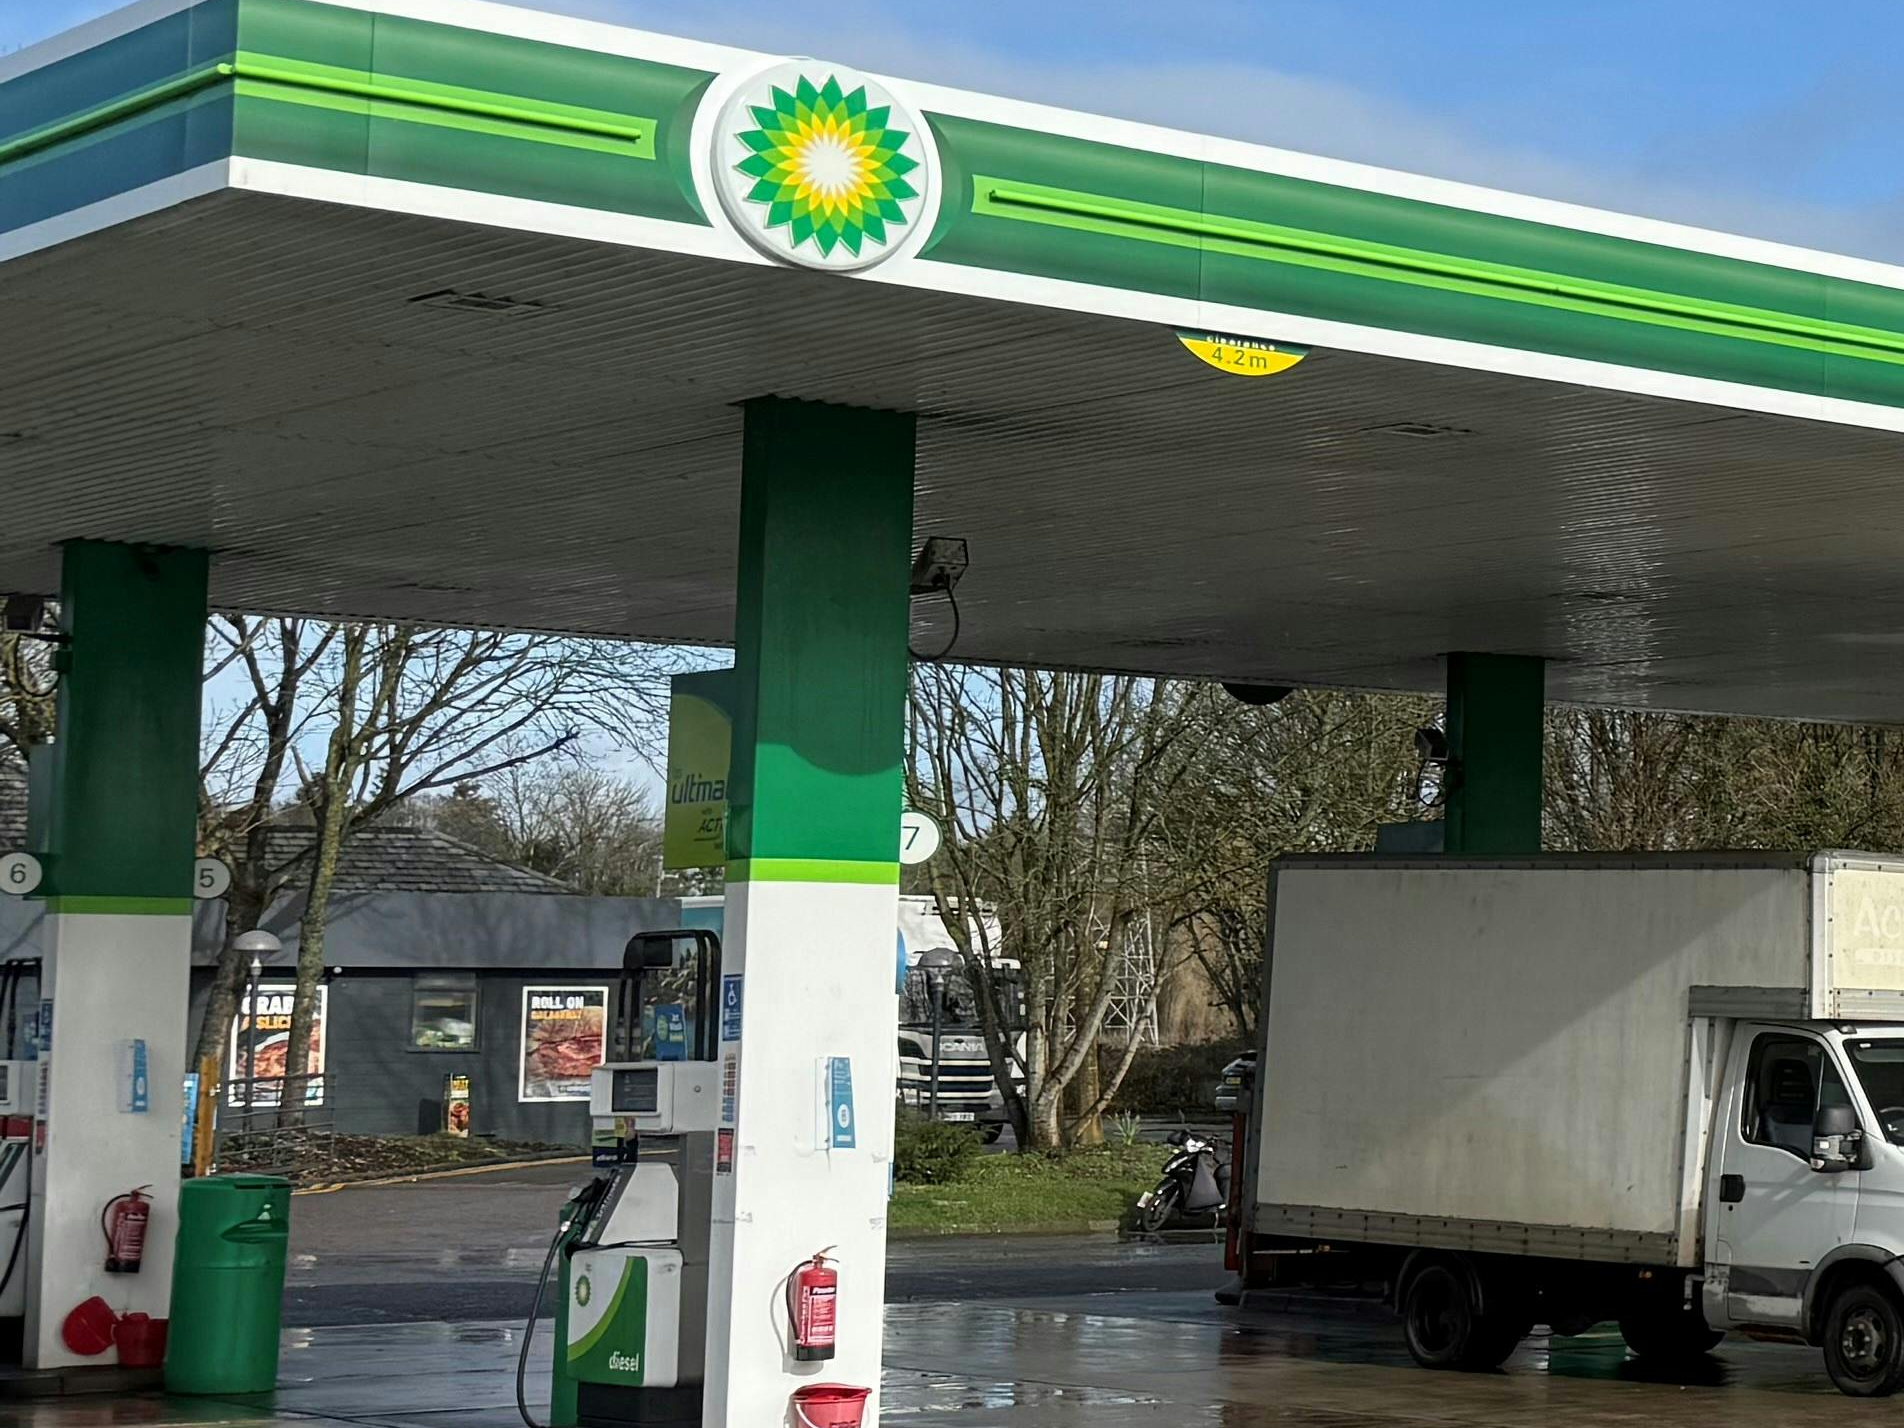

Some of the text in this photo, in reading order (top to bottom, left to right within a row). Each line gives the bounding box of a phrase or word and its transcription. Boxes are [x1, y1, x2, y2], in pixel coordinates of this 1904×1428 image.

[902, 826, 920, 850] 7
[9, 863, 27, 884] 6
[200, 868, 215, 888] 5
[939, 1042, 985, 1052] CANIA
[608, 1351, 640, 1372] diesel
